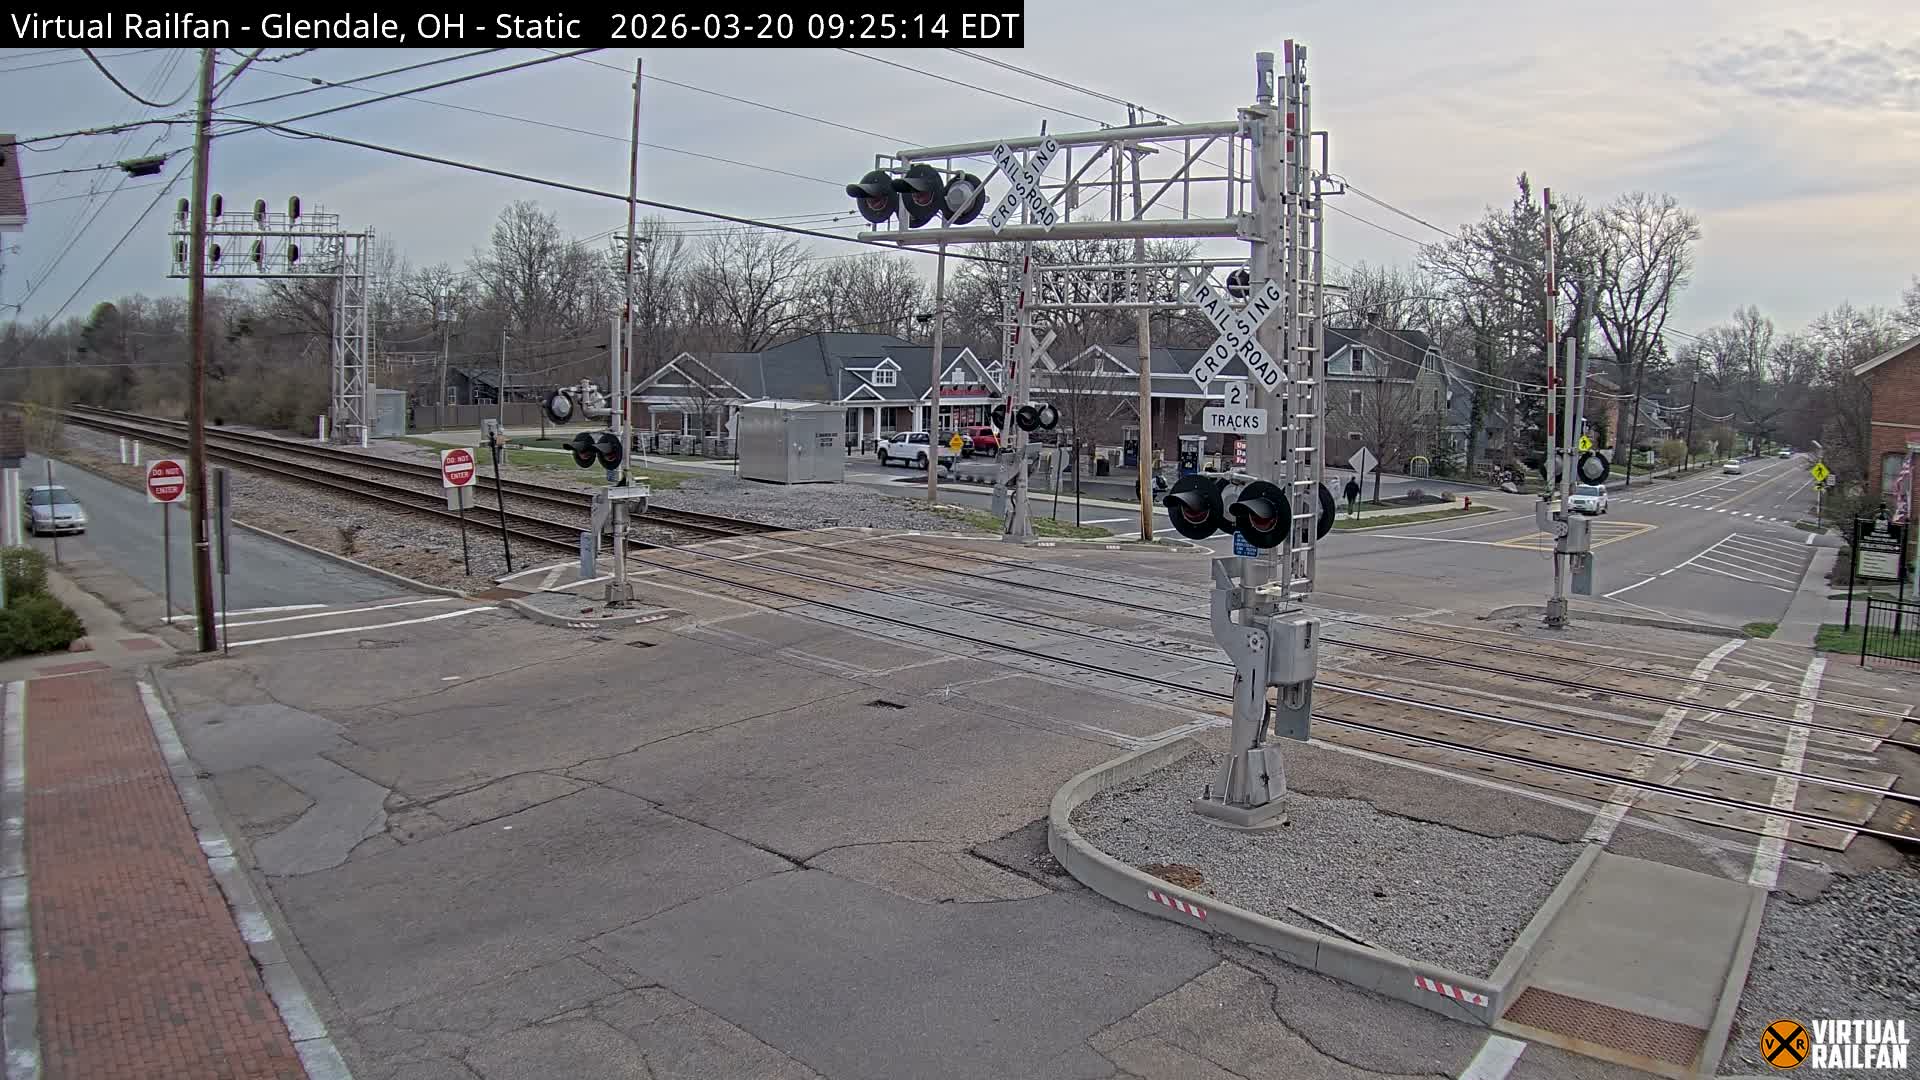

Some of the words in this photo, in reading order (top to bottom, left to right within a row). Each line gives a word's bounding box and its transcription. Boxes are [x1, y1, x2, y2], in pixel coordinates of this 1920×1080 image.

[991, 140, 1056, 228] CROSSING
[1195, 286, 1280, 383] CROSSING
[1230, 387, 1240, 404] 2
[1212, 414, 1259, 428] TRACKS
[450, 472, 469, 480] ENTER
